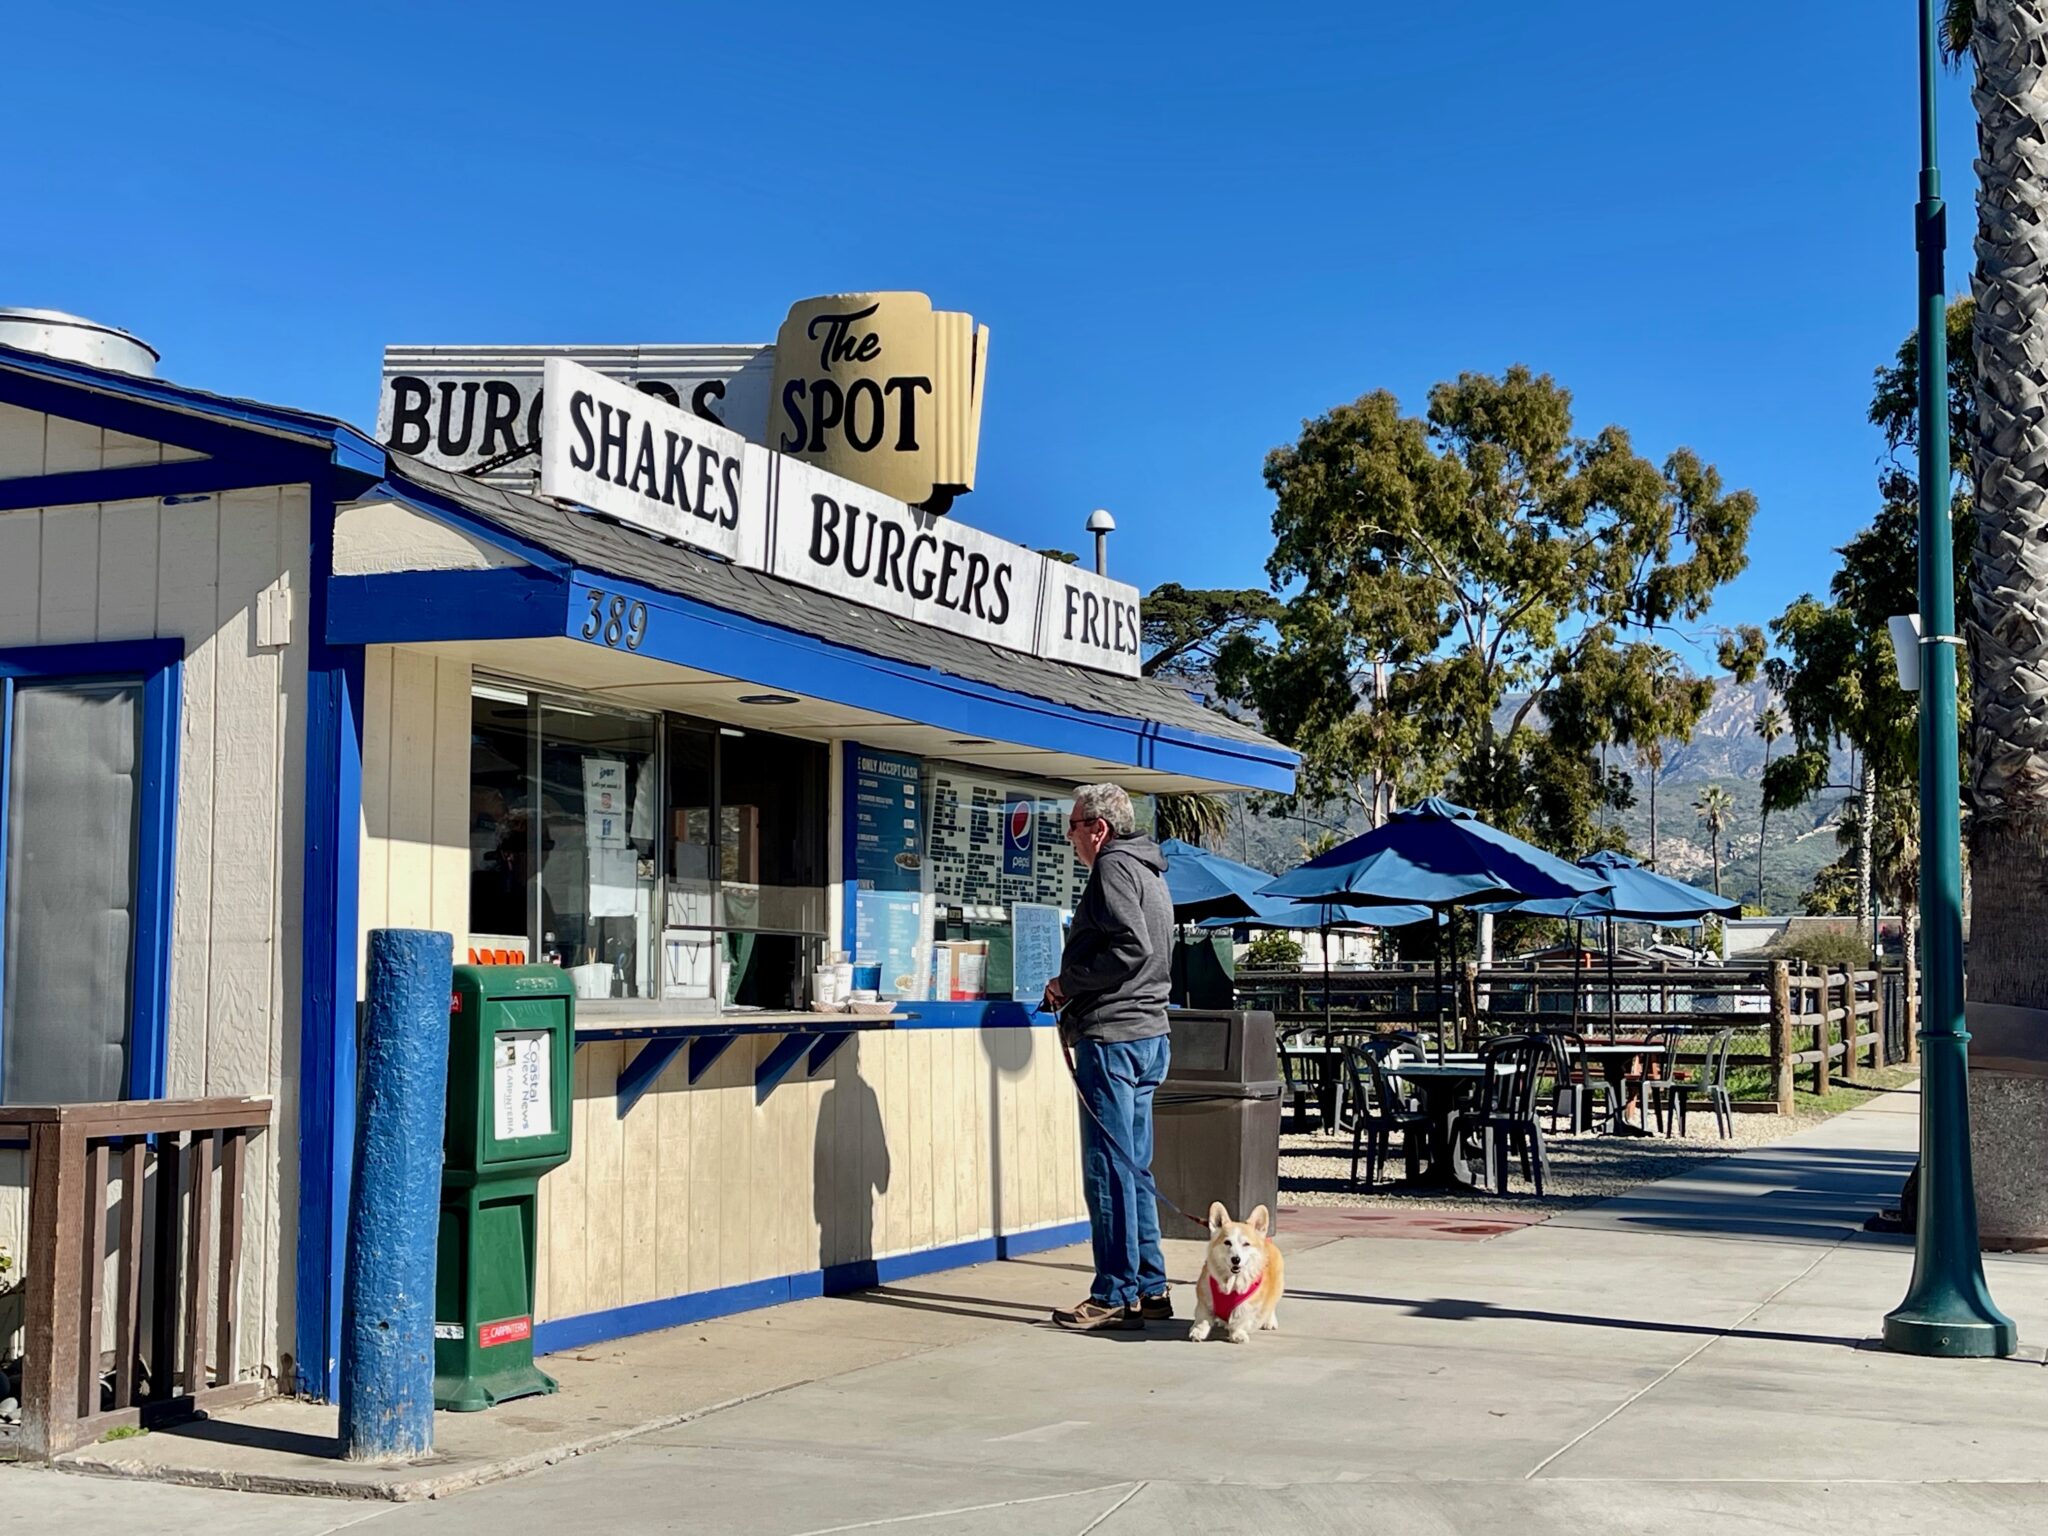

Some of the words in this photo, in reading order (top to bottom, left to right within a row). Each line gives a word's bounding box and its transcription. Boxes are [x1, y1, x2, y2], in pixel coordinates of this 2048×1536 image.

[807, 302, 882, 372] The
[780, 376, 933, 453] SPOT
[569, 390, 741, 531] SHAKES
[808, 493, 1012, 625] BURGERS
[1063, 584, 1138, 656] FRIES
[582, 589, 648, 651] 389
[862, 758, 877, 772] ONLY
[879, 761, 901, 776] ACCEPT
[902, 765, 918, 779] CASH
[522, 1052, 530, 1086] View
[529, 1038, 541, 1103] Coastal
[521, 1091, 530, 1130] News
